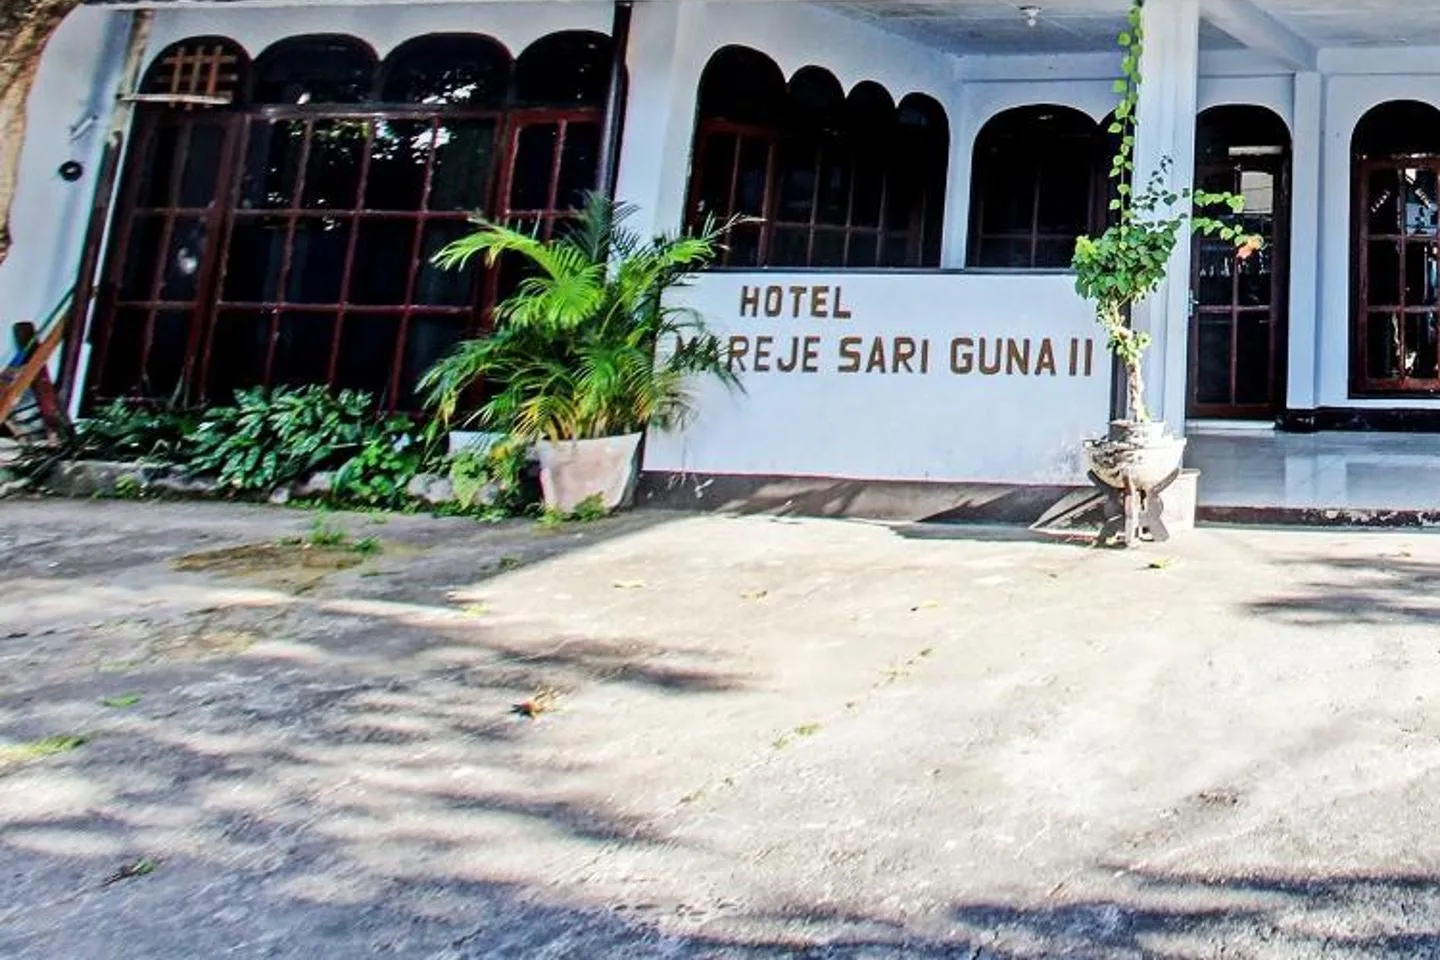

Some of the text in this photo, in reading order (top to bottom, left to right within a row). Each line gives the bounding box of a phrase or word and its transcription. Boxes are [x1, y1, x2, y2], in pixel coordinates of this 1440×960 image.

[739, 285, 852, 319] HOTEL
[838, 336, 928, 374] SARI
[950, 337, 1057, 376] GUNA
